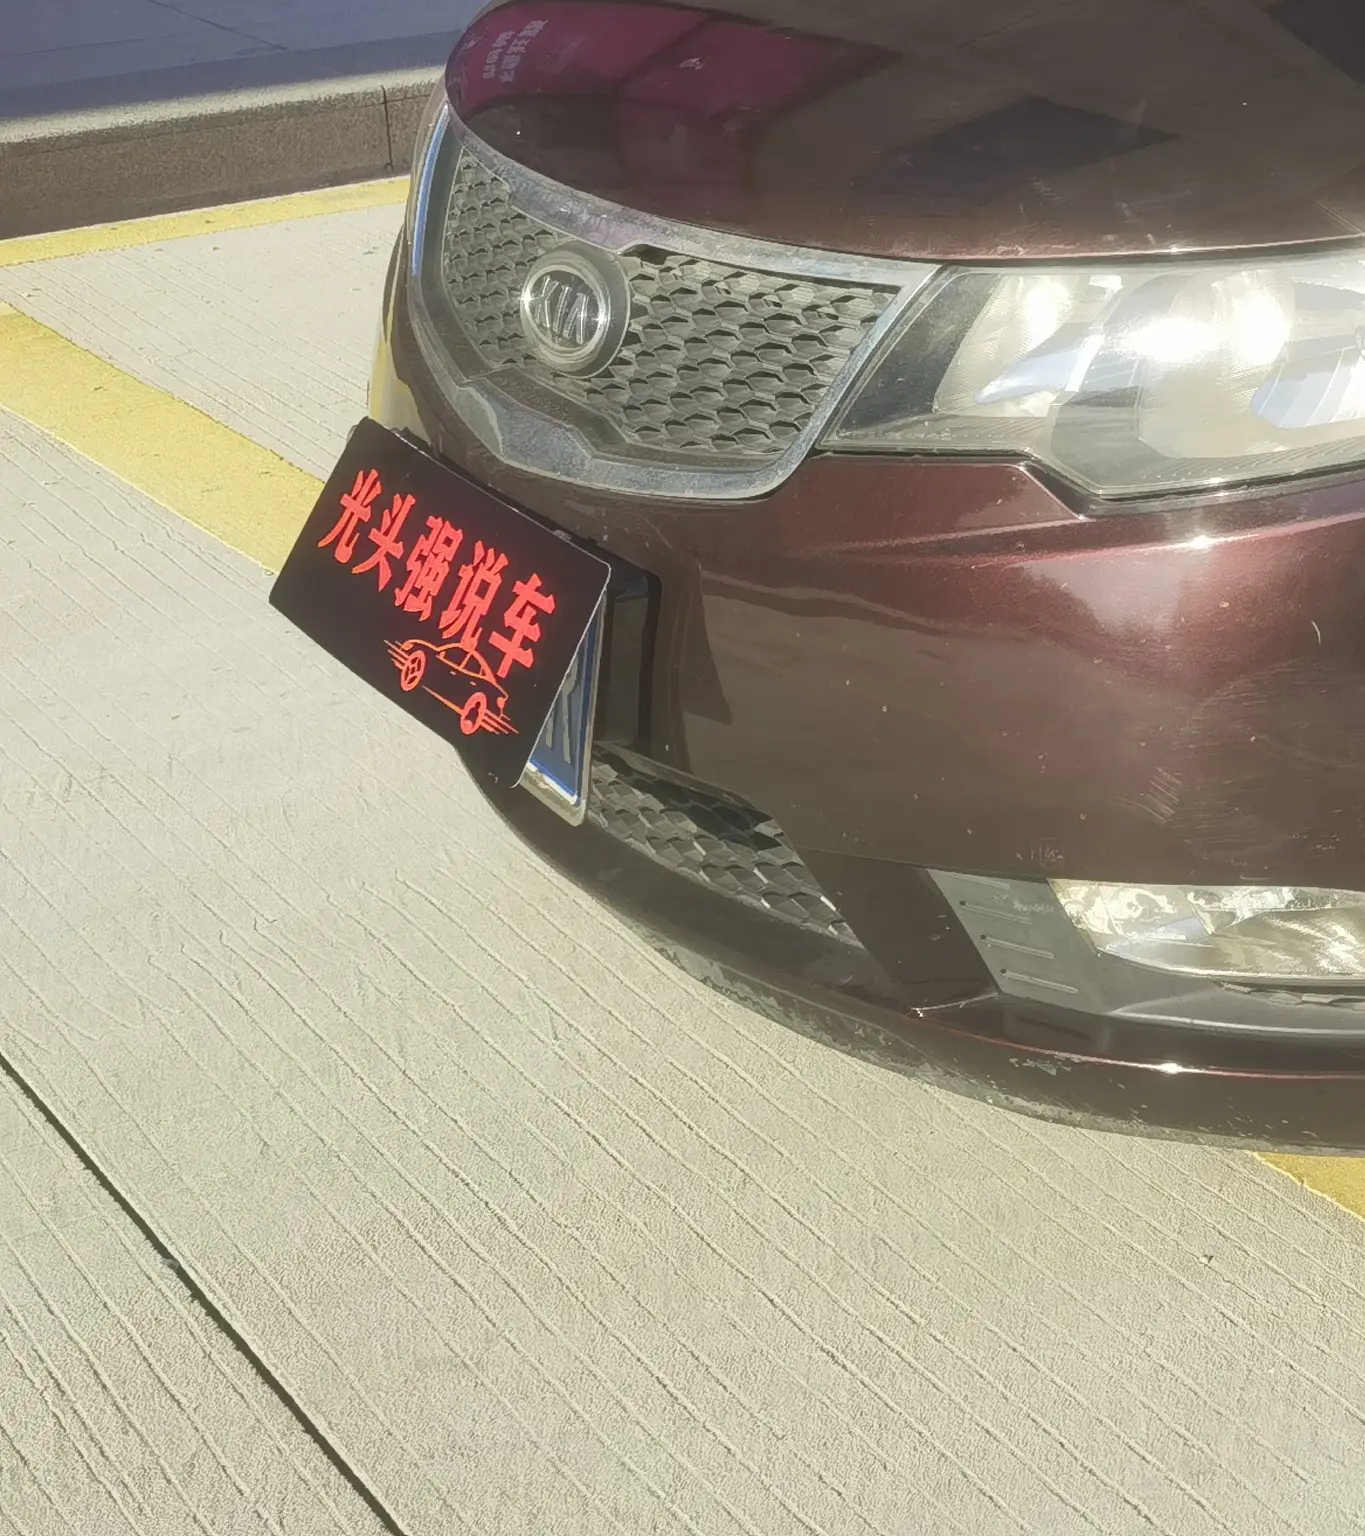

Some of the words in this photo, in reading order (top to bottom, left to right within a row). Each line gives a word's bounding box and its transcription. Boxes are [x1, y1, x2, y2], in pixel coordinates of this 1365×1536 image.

[317, 468, 556, 679] 光头强说车
